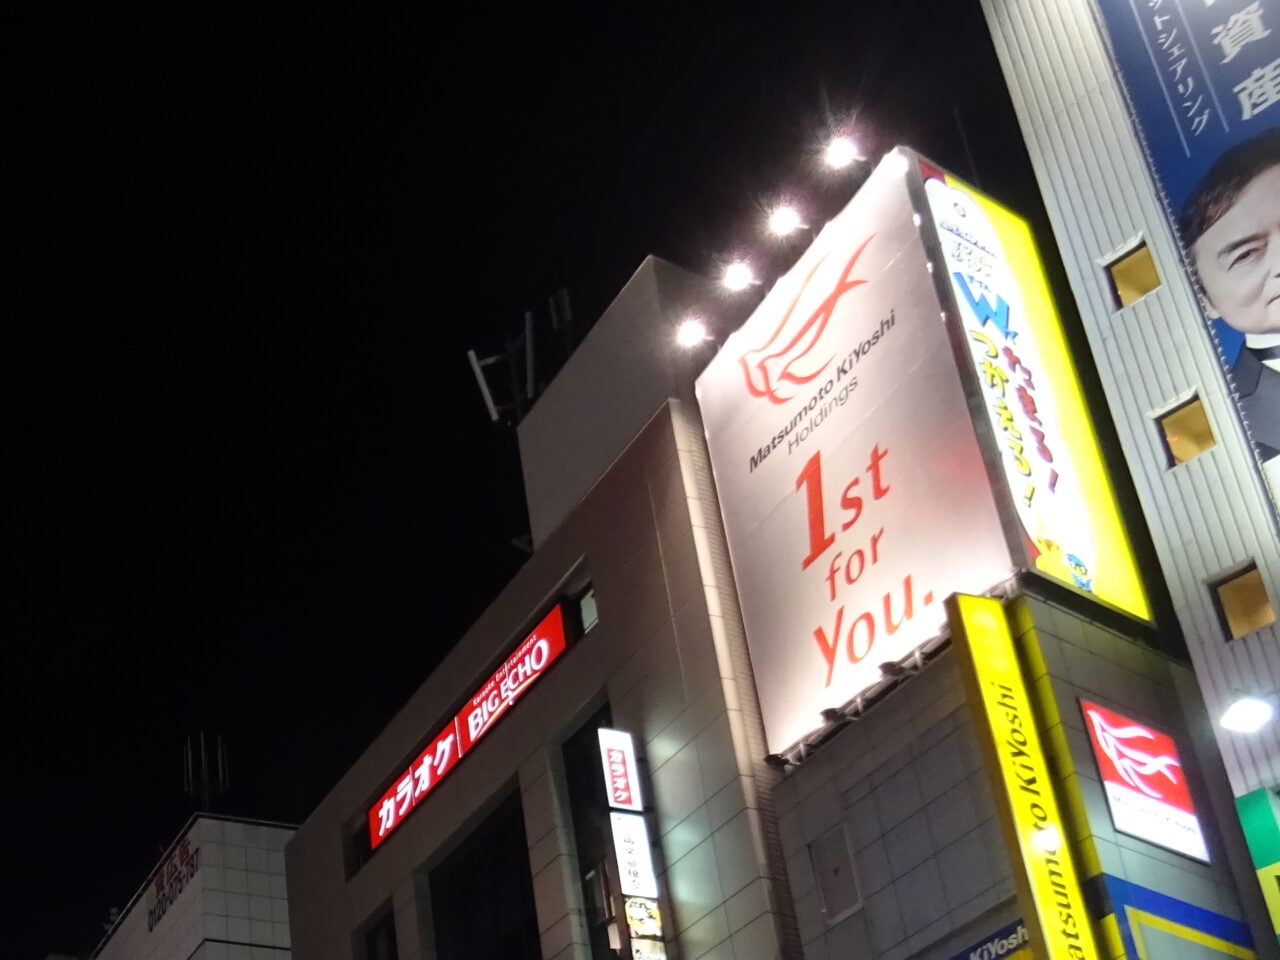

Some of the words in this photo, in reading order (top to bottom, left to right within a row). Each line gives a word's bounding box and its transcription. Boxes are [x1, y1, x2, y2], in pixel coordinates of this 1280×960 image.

[952, 272, 1011, 341] W
[748, 380, 834, 473] Matsumoto
[835, 309, 897, 383] KiYoshi
[787, 376, 859, 455] Holdings
[795, 442, 890, 570] 1st
[825, 527, 885, 602] for
[813, 574, 934, 688] You.
[468, 689, 499, 742] BIG
[500, 638, 549, 698] ECHO
[472, 680, 496, 706] Karaoke
[991, 681, 1039, 796] KiYoshi
[378, 733, 454, 836] カラオケ
